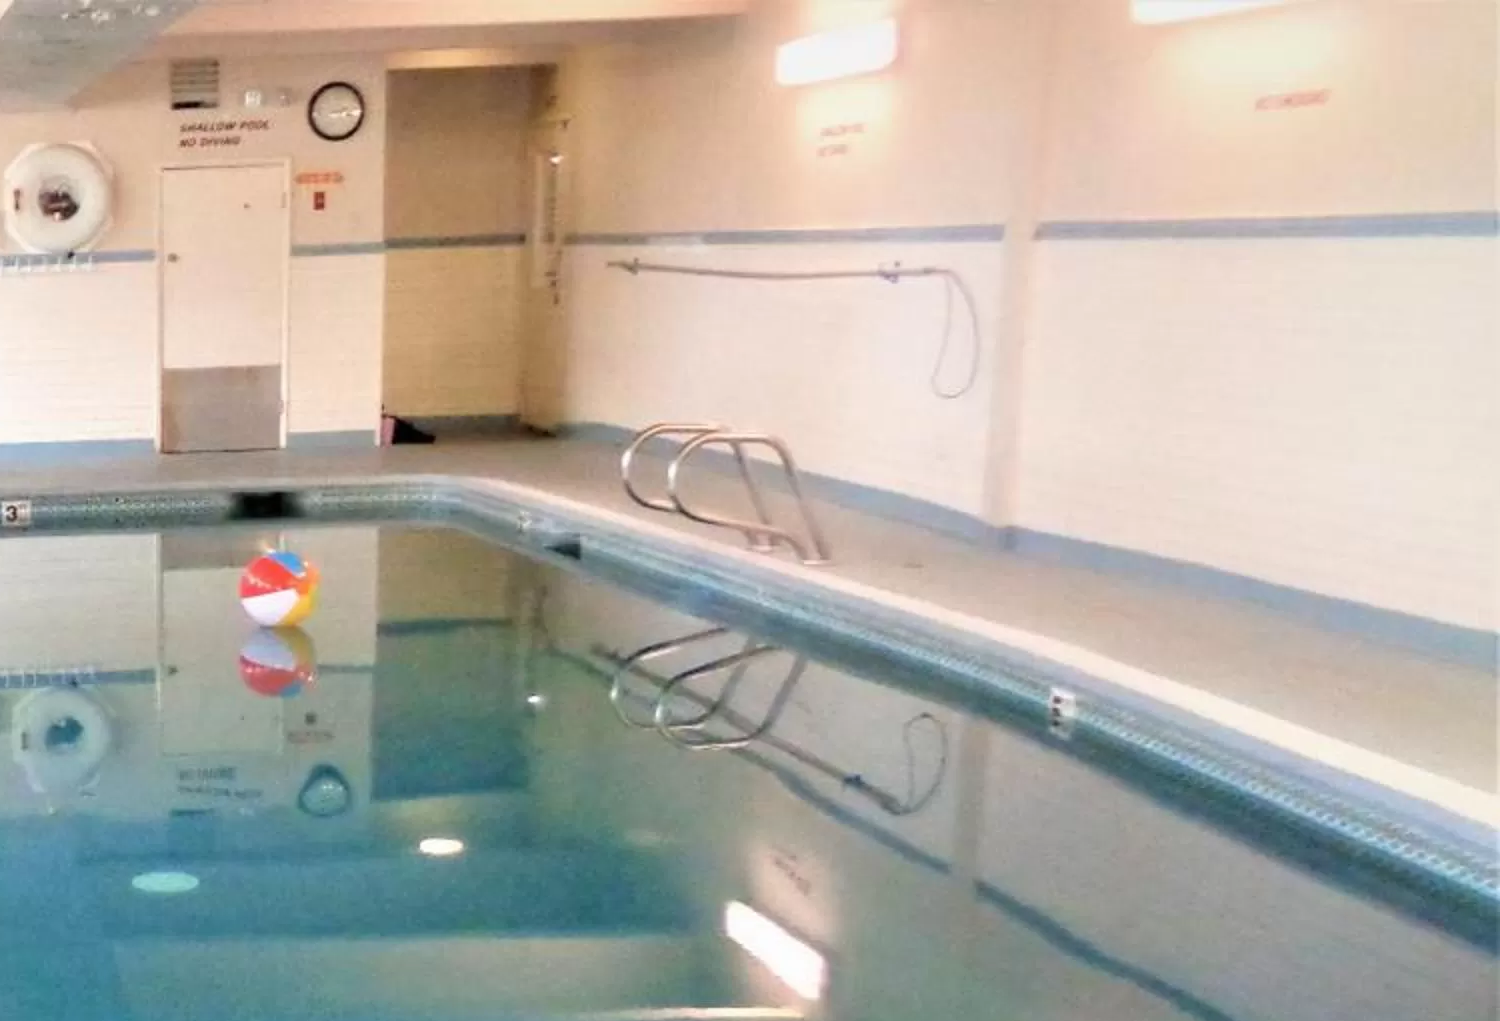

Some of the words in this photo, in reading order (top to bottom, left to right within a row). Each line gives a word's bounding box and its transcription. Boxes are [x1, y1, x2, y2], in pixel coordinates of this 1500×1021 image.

[179, 121, 237, 133] SHALLOW
[240, 119, 269, 131] POOL
[179, 138, 197, 148] NO
[200, 136, 241, 147] DIVING
[5, 504, 19, 522] 3
